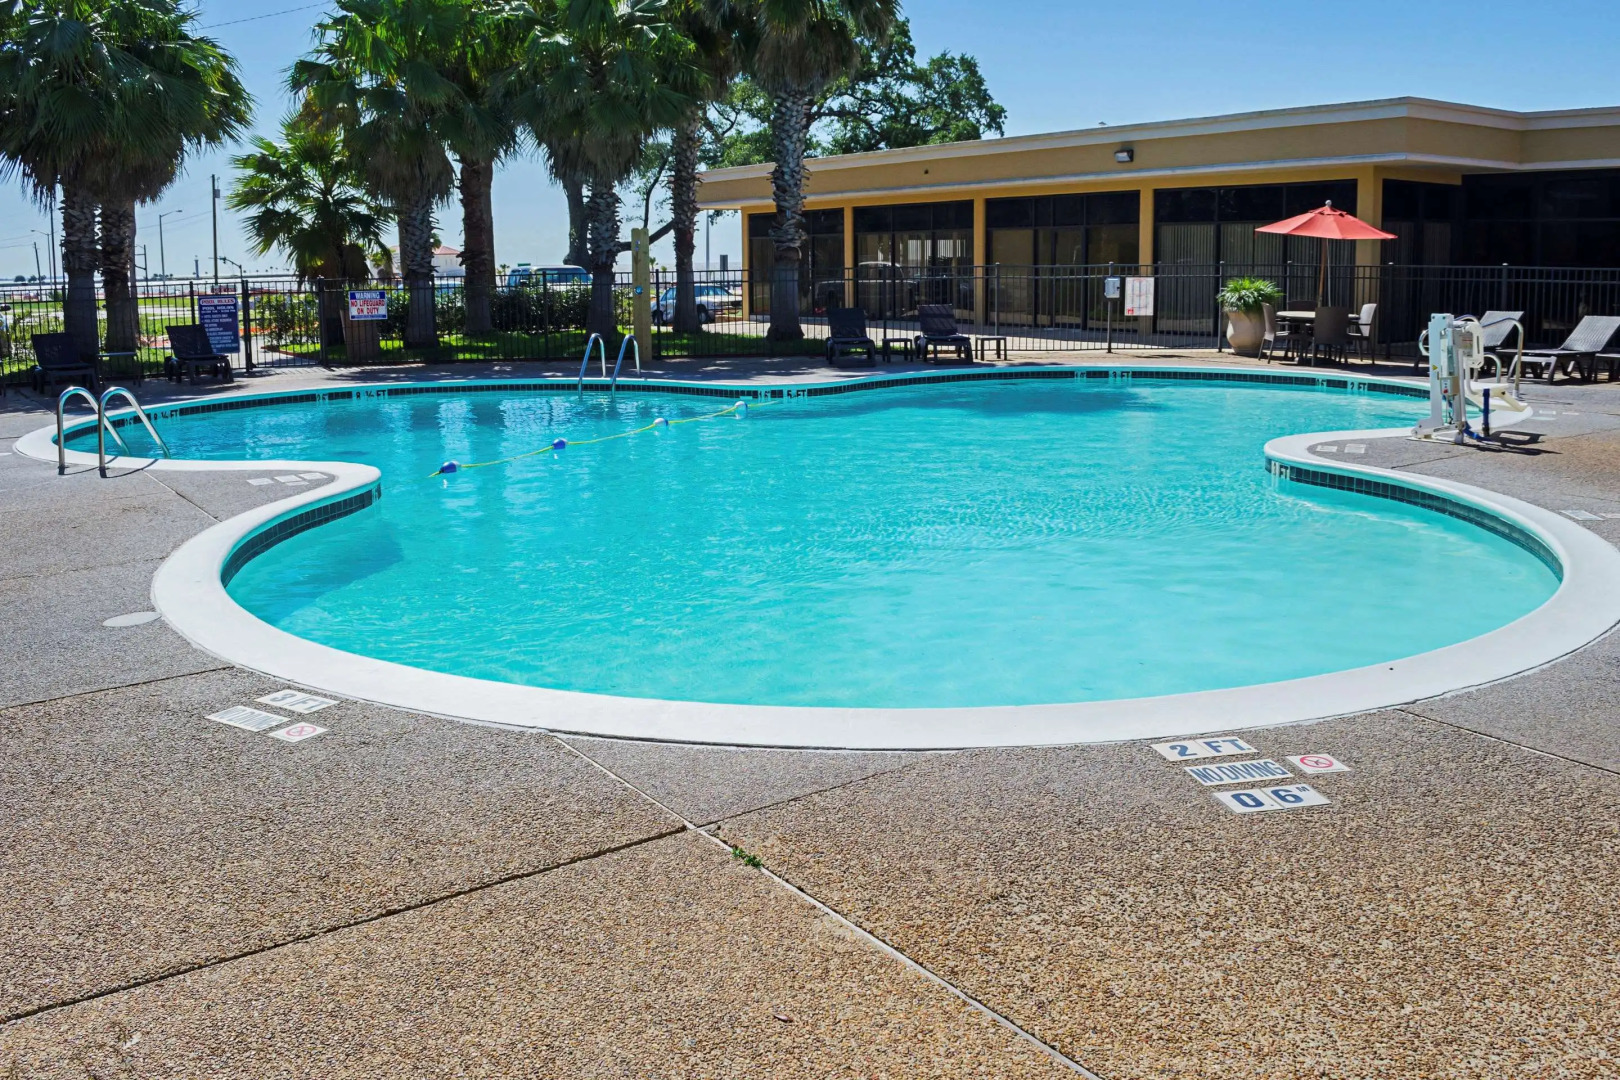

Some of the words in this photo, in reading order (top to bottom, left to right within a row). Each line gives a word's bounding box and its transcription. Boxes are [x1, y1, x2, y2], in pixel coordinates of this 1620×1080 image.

[1358, 382, 1366, 390] FT
[376, 390, 386, 398] FT
[796, 390, 806, 398] FT
[170, 410, 178, 418] FT
[288, 698, 332, 710] FT
[1169, 744, 1197, 757] 2
[1190, 766, 1224, 783] NO
[1220, 761, 1289, 780] DIVING
